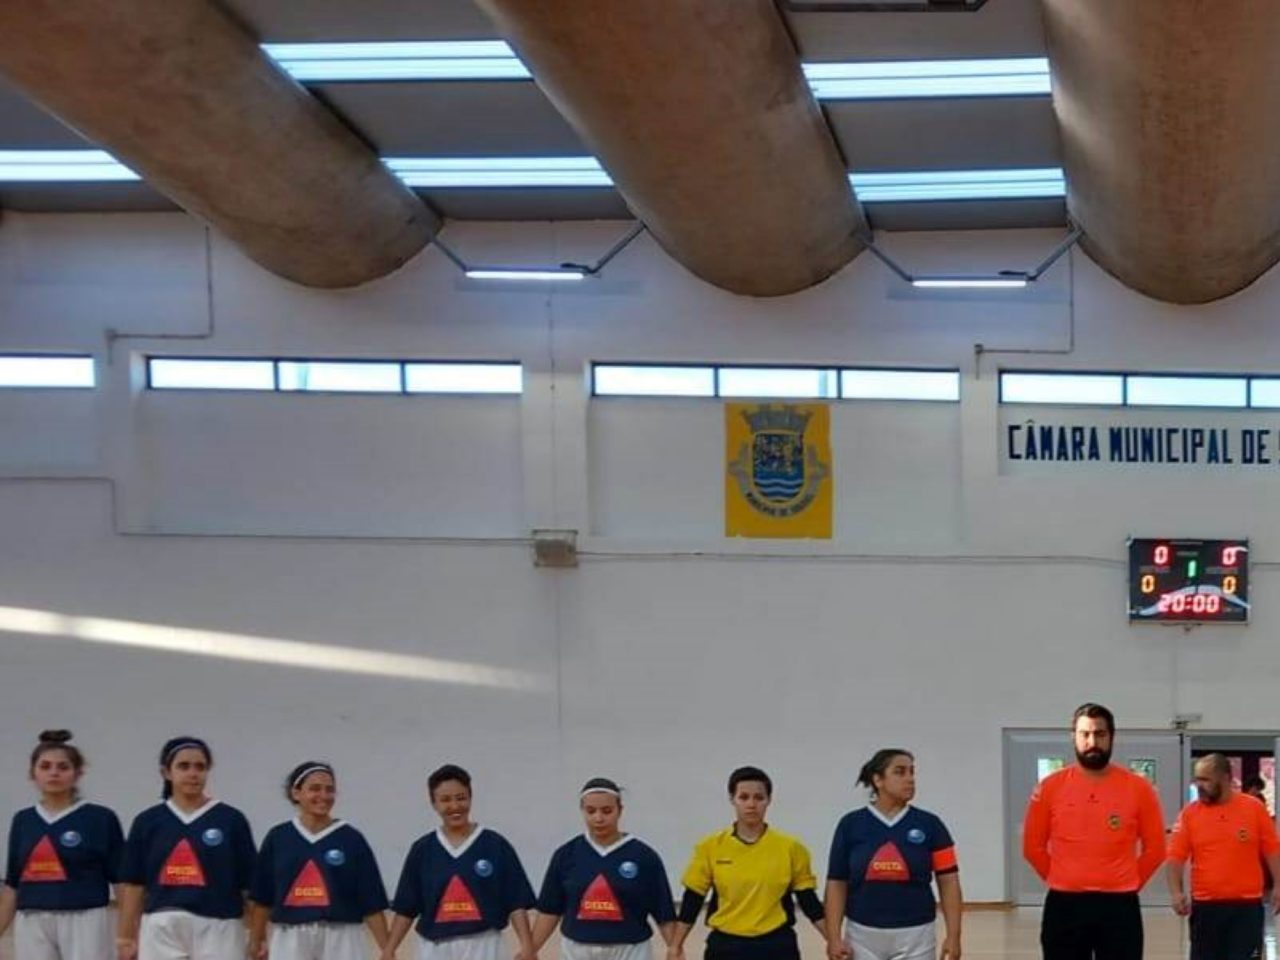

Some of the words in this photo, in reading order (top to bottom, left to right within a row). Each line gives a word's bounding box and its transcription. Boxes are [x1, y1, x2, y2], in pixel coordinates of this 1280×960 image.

[1008, 419, 1100, 461] CÂMARA
[1109, 427, 1233, 463] MUNICIPAL
[1241, 429, 1271, 464] DE
[1154, 546, 1168, 565] 0
[1188, 560, 1197, 577] 1
[1141, 575, 1155, 593] 0
[1223, 576, 1236, 594] 0
[1159, 594, 1219, 613] 20:00
